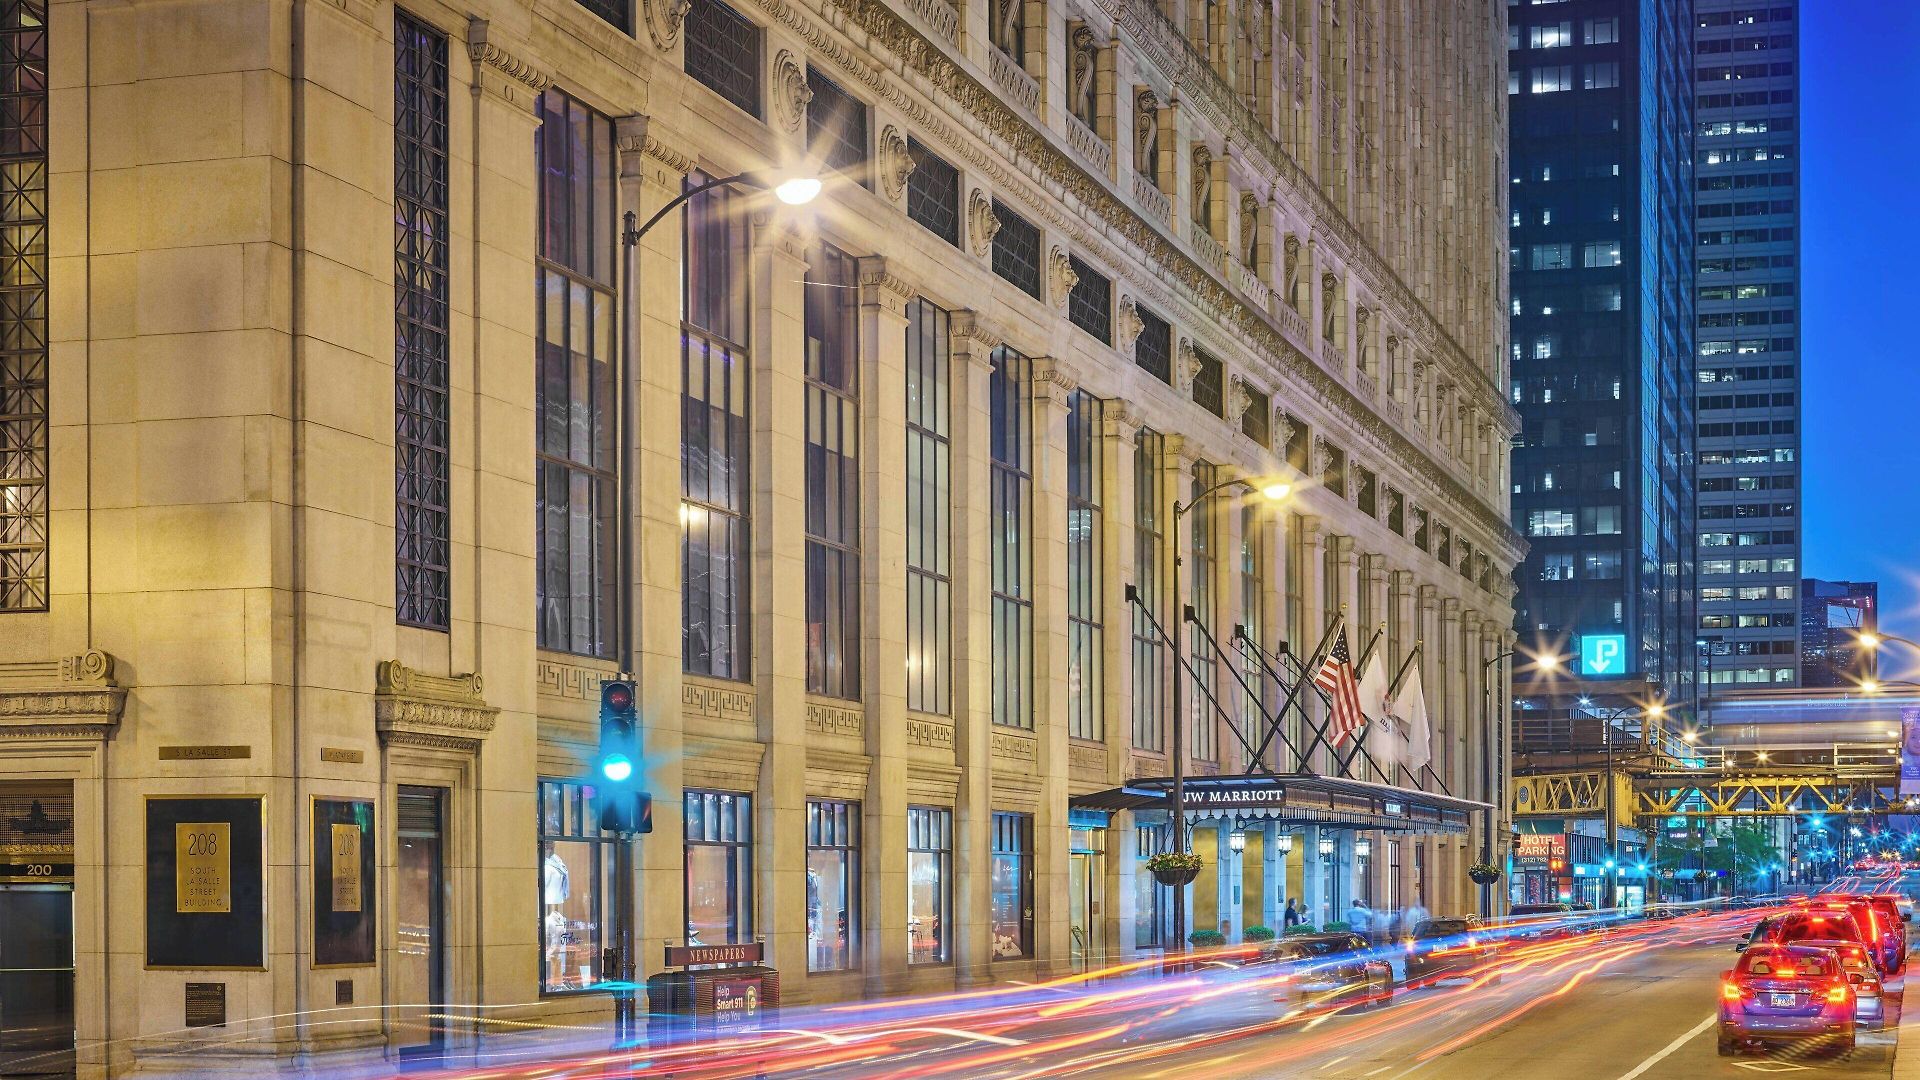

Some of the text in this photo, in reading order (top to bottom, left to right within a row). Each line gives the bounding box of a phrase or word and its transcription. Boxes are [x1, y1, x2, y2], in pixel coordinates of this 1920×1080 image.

[1183, 790, 1283, 803] JW MARRIOTT
[189, 833, 217, 856] 208
[339, 834, 354, 856] 208
[1524, 836, 1559, 845] HOTEL
[1519, 846, 1565, 855] PARKING
[27, 864, 52, 876] 200
[190, 867, 216, 875] SOUTH
[198, 877, 220, 885] SALLE
[190, 888, 217, 896] STREET
[184, 898, 222, 907] BUILDING
[689, 947, 745, 962] NEWSPAPERS
[717, 985, 730, 998] Help
[716, 997, 743, 1010] Smart 911
[717, 1011, 730, 1023] Help
